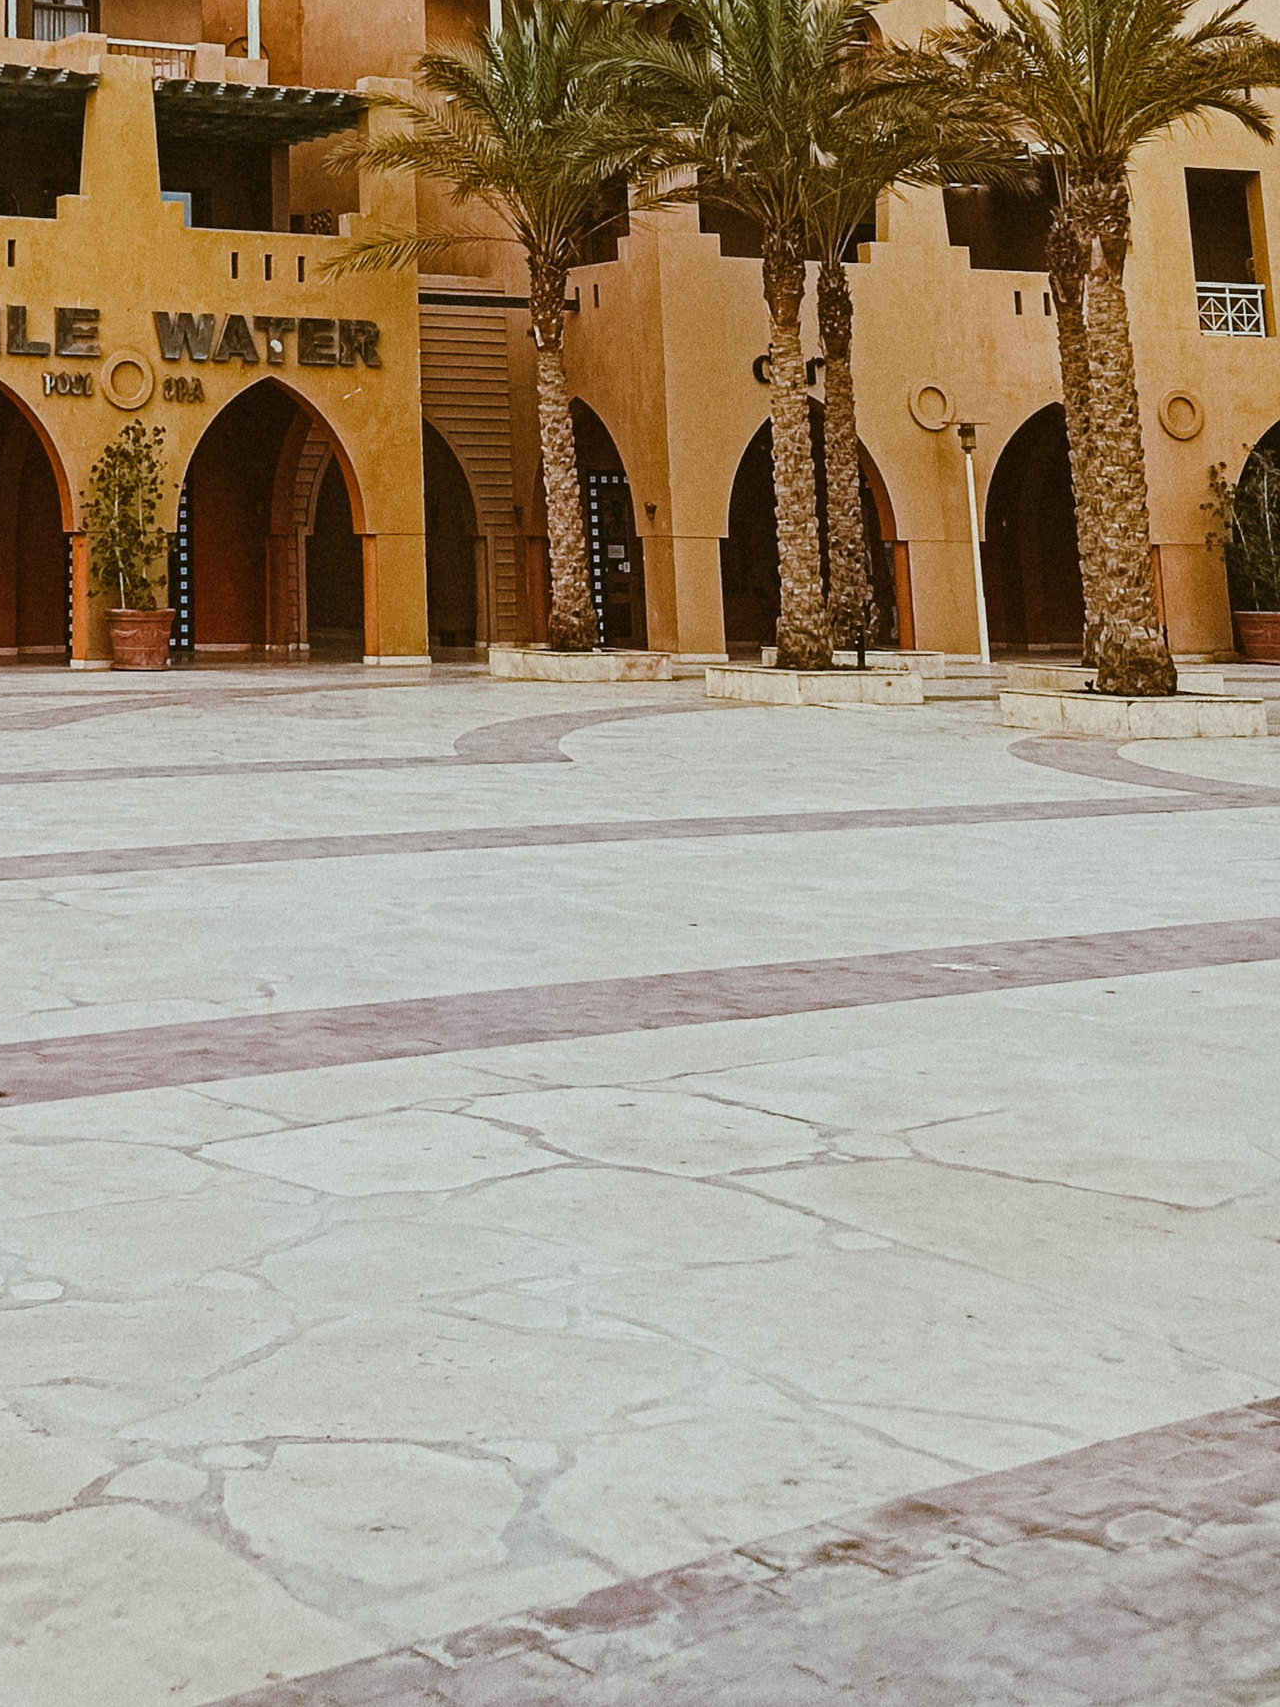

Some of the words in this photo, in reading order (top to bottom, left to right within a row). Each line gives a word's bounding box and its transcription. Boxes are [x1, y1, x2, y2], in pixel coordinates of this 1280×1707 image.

[150, 310, 382, 367] WATER
[42, 370, 94, 397] POOL
[162, 374, 205, 403] SPA
